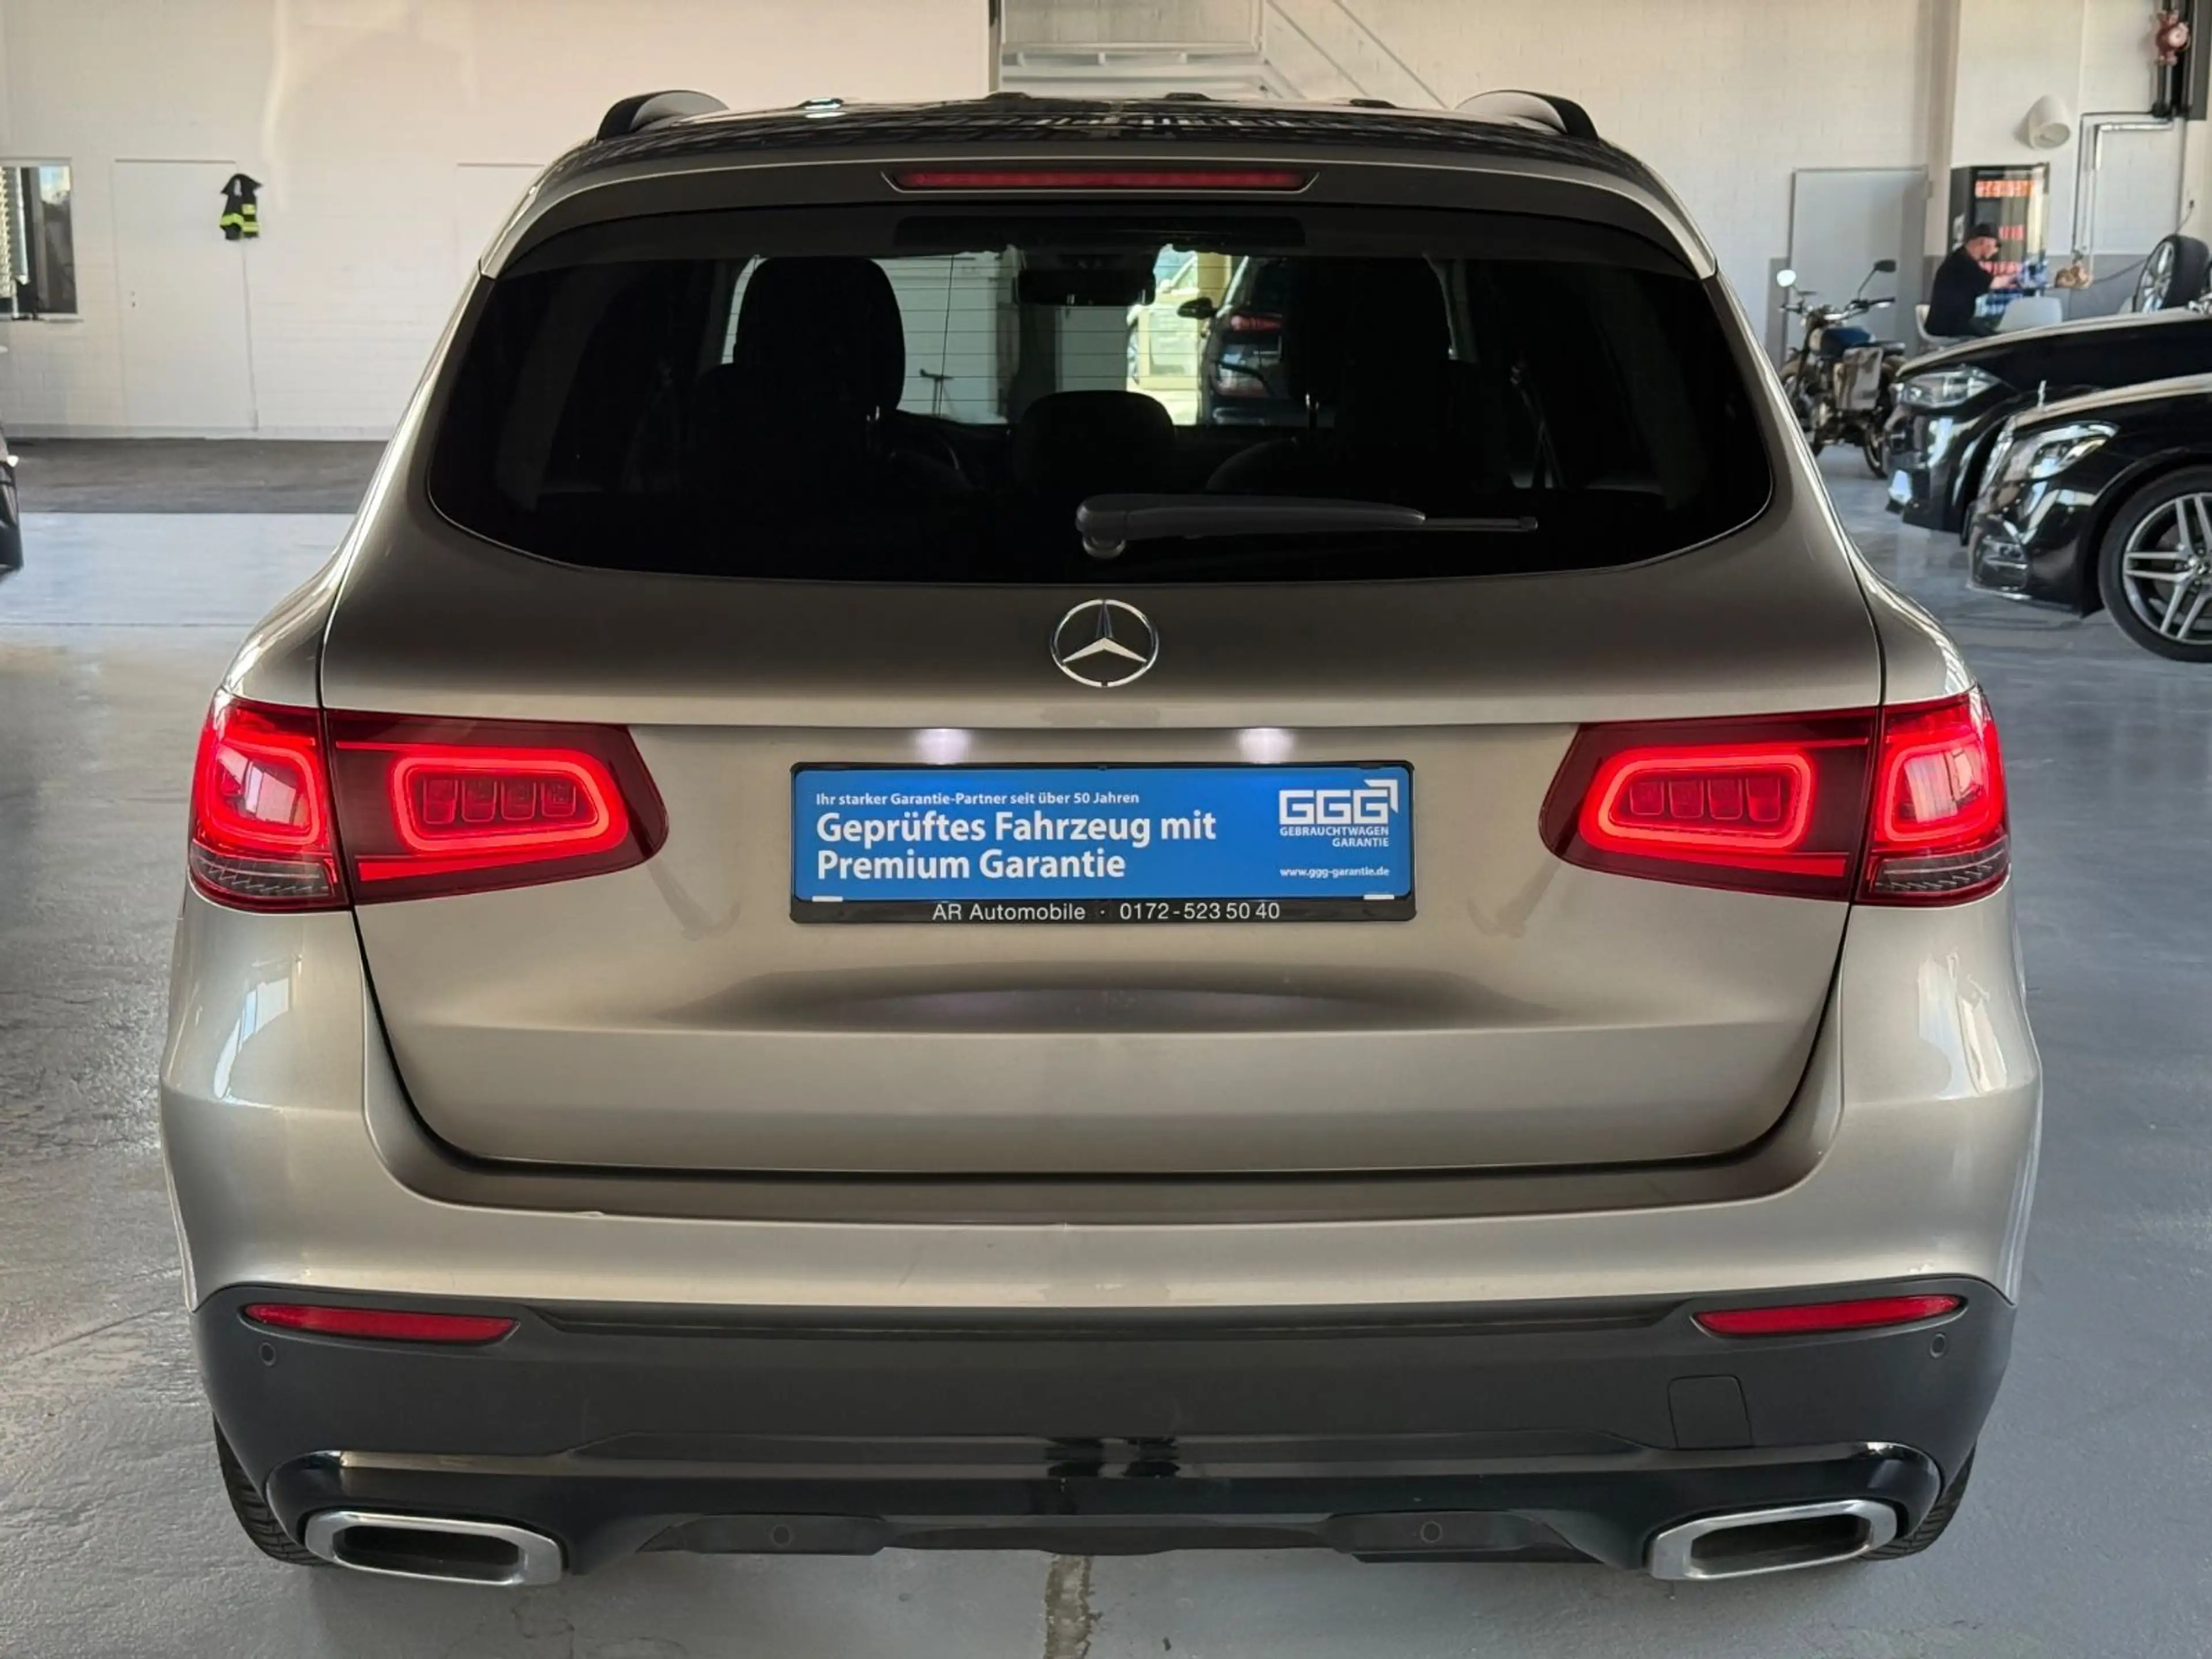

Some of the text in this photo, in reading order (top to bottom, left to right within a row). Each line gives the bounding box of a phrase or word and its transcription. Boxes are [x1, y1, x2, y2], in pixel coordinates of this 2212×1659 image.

[816, 791, 1139, 805] Ihr starker Garantie-Partner seit über 50 Jahren
[1279, 789, 1389, 825] GGG
[816, 809, 1217, 850] Geprüftes Fahrzeug mit
[1279, 826, 1389, 836] GEBRAUCHTWAGEN
[1332, 838, 1389, 847] GARANTIE
[817, 847, 1126, 880] Premium Garantie
[1279, 866, 1389, 879] www.ggg-garantie.de
[931, 904, 963, 921] AR
[969, 902, 1086, 921] Automobile
[1225, 902, 1251, 920] 50
[1254, 902, 1281, 920] 40
